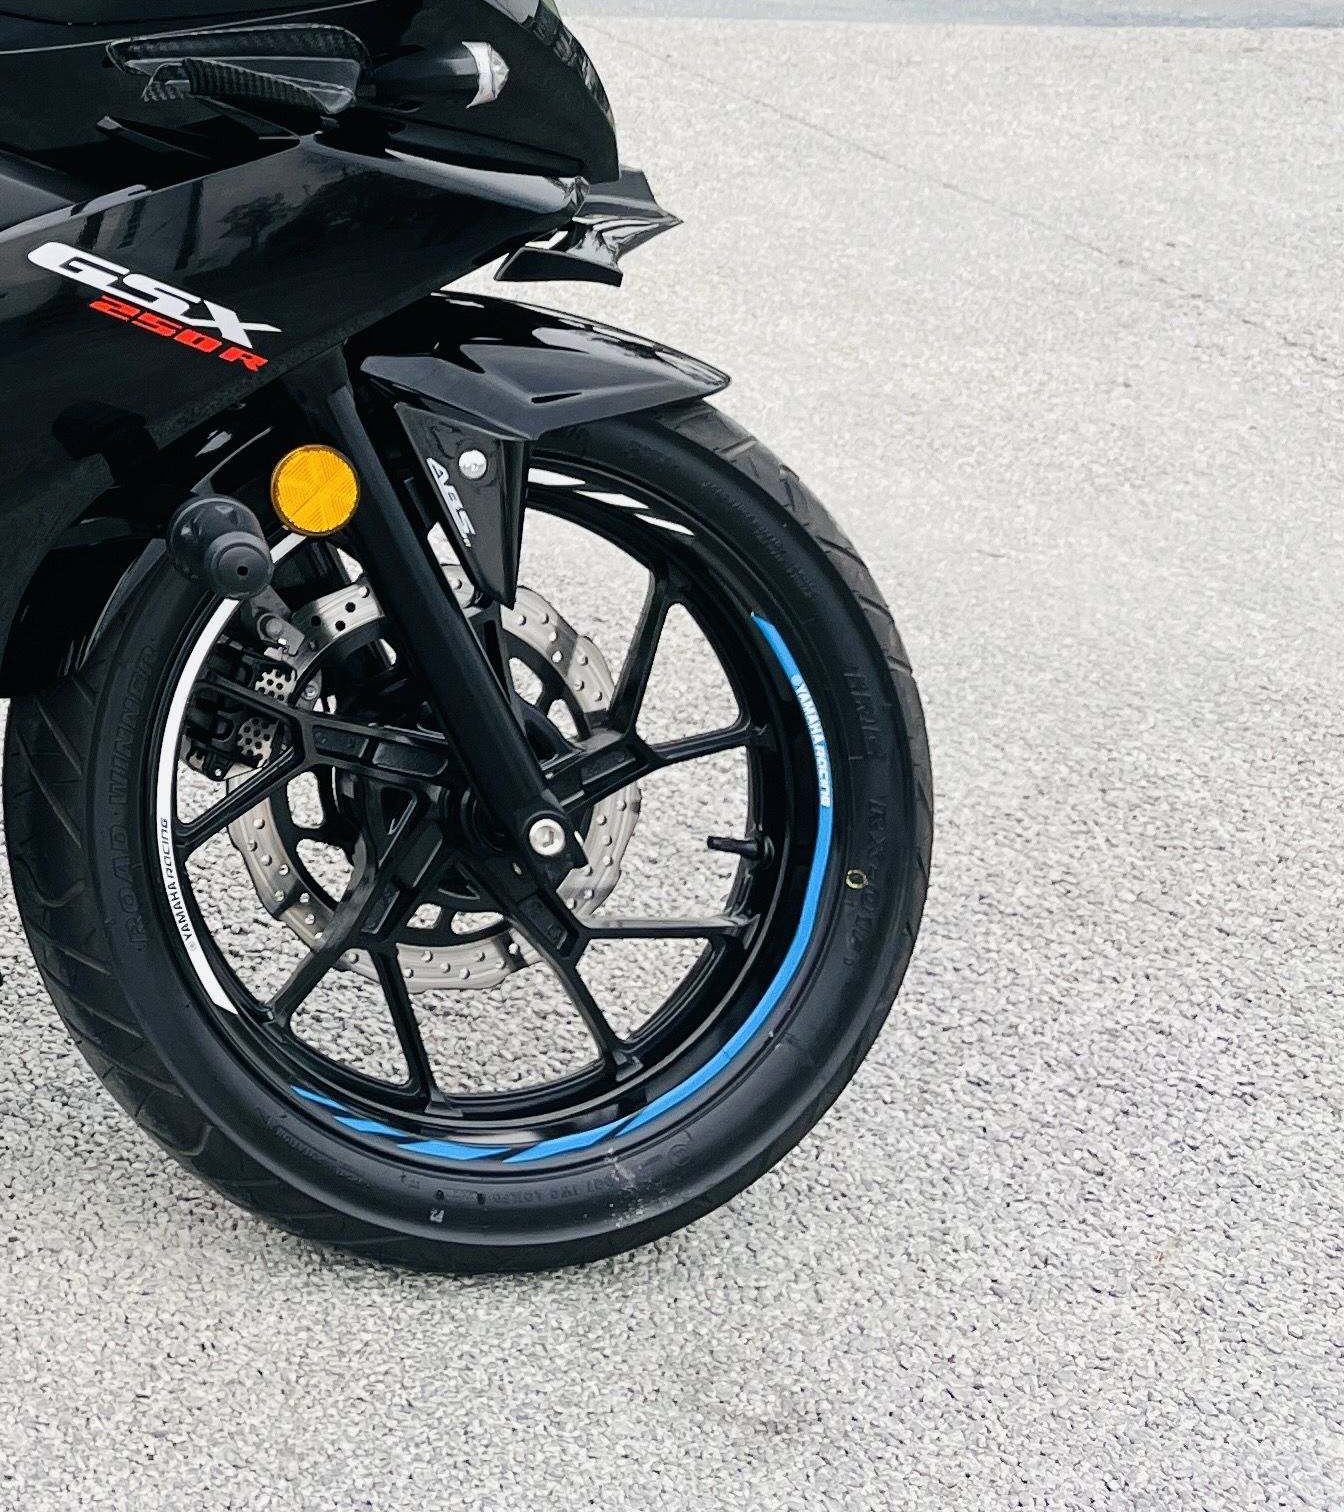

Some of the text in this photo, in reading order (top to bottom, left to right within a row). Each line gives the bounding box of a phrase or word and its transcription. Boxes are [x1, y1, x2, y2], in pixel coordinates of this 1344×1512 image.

[27, 241, 283, 350] GSX
[89, 295, 269, 373] 250R
[797, 681, 827, 744] YAMAHA
[159, 817, 194, 941] YAMAHA RACING
